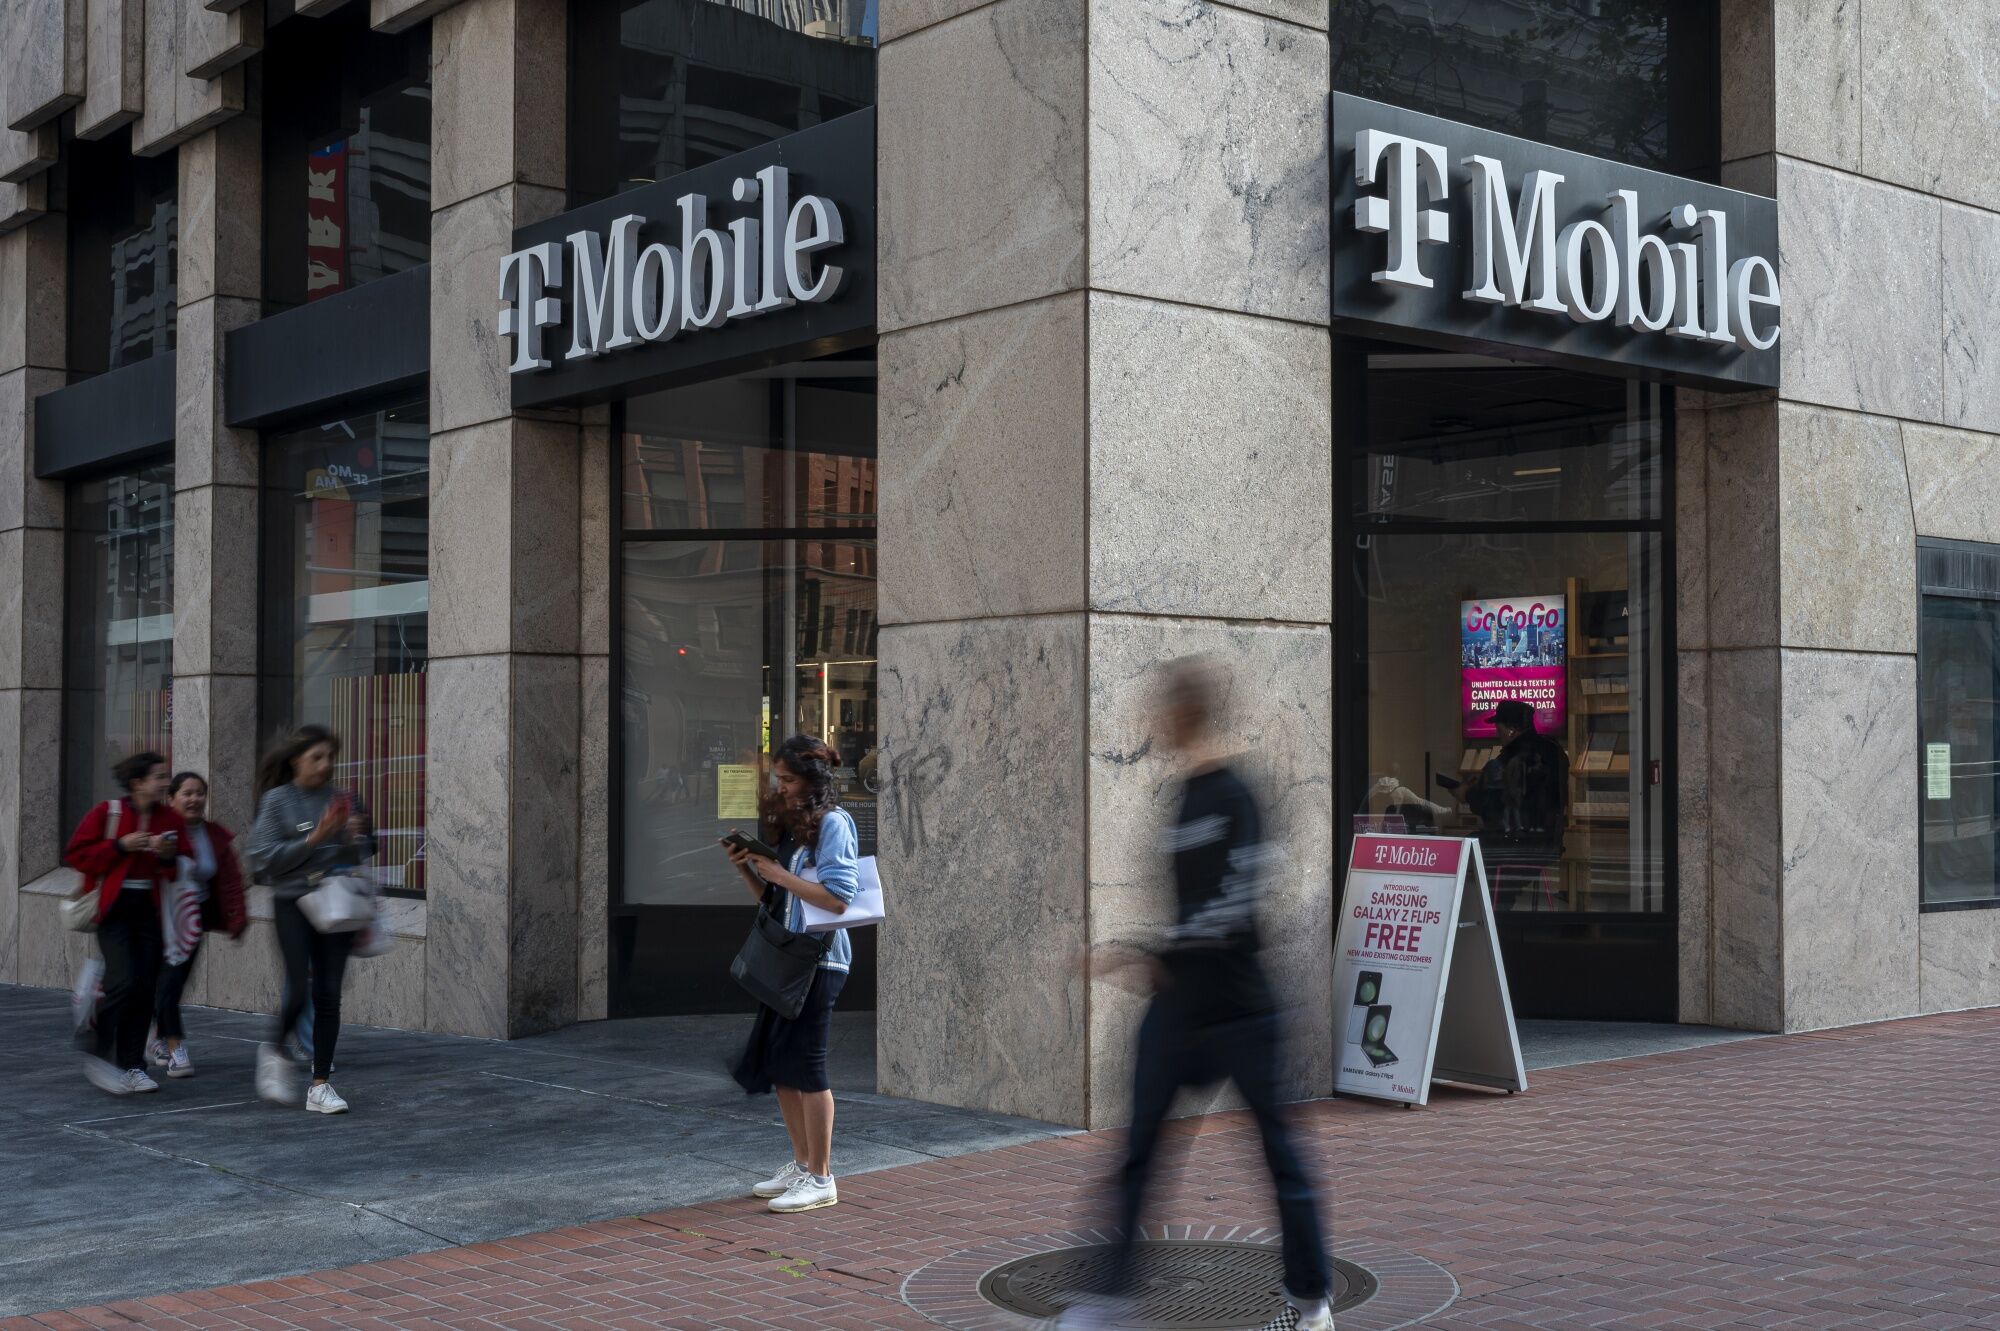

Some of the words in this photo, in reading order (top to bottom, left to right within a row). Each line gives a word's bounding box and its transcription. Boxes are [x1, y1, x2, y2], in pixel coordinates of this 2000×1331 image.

[1461, 154, 1781, 351] Mobile
[564, 165, 844, 360] Mobile
[1528, 679, 1547, 687] TEXTS
[1471, 690, 1509, 700] CANADA
[1511, 689, 1517, 699] &
[1519, 688, 1556, 699] MEXICO
[1471, 702, 1489, 711] PLUS
[1536, 701, 1556, 709] DATA
[1388, 845, 1437, 866] Mobile
[1382, 884, 1420, 893] INTRODUCING
[1370, 892, 1428, 908] SAMSUNG
[1353, 905, 1401, 922] GALAXY
[1401, 909, 1410, 922] Z
[1410, 910, 1441, 924] FLIP5
[1364, 922, 1422, 953] FREE
[1346, 949, 1361, 957] NEW
[1361, 950, 1374, 958] AND
[1373, 951, 1399, 961] EXISTING
[1398, 954, 1432, 964] CUSTOMERS
